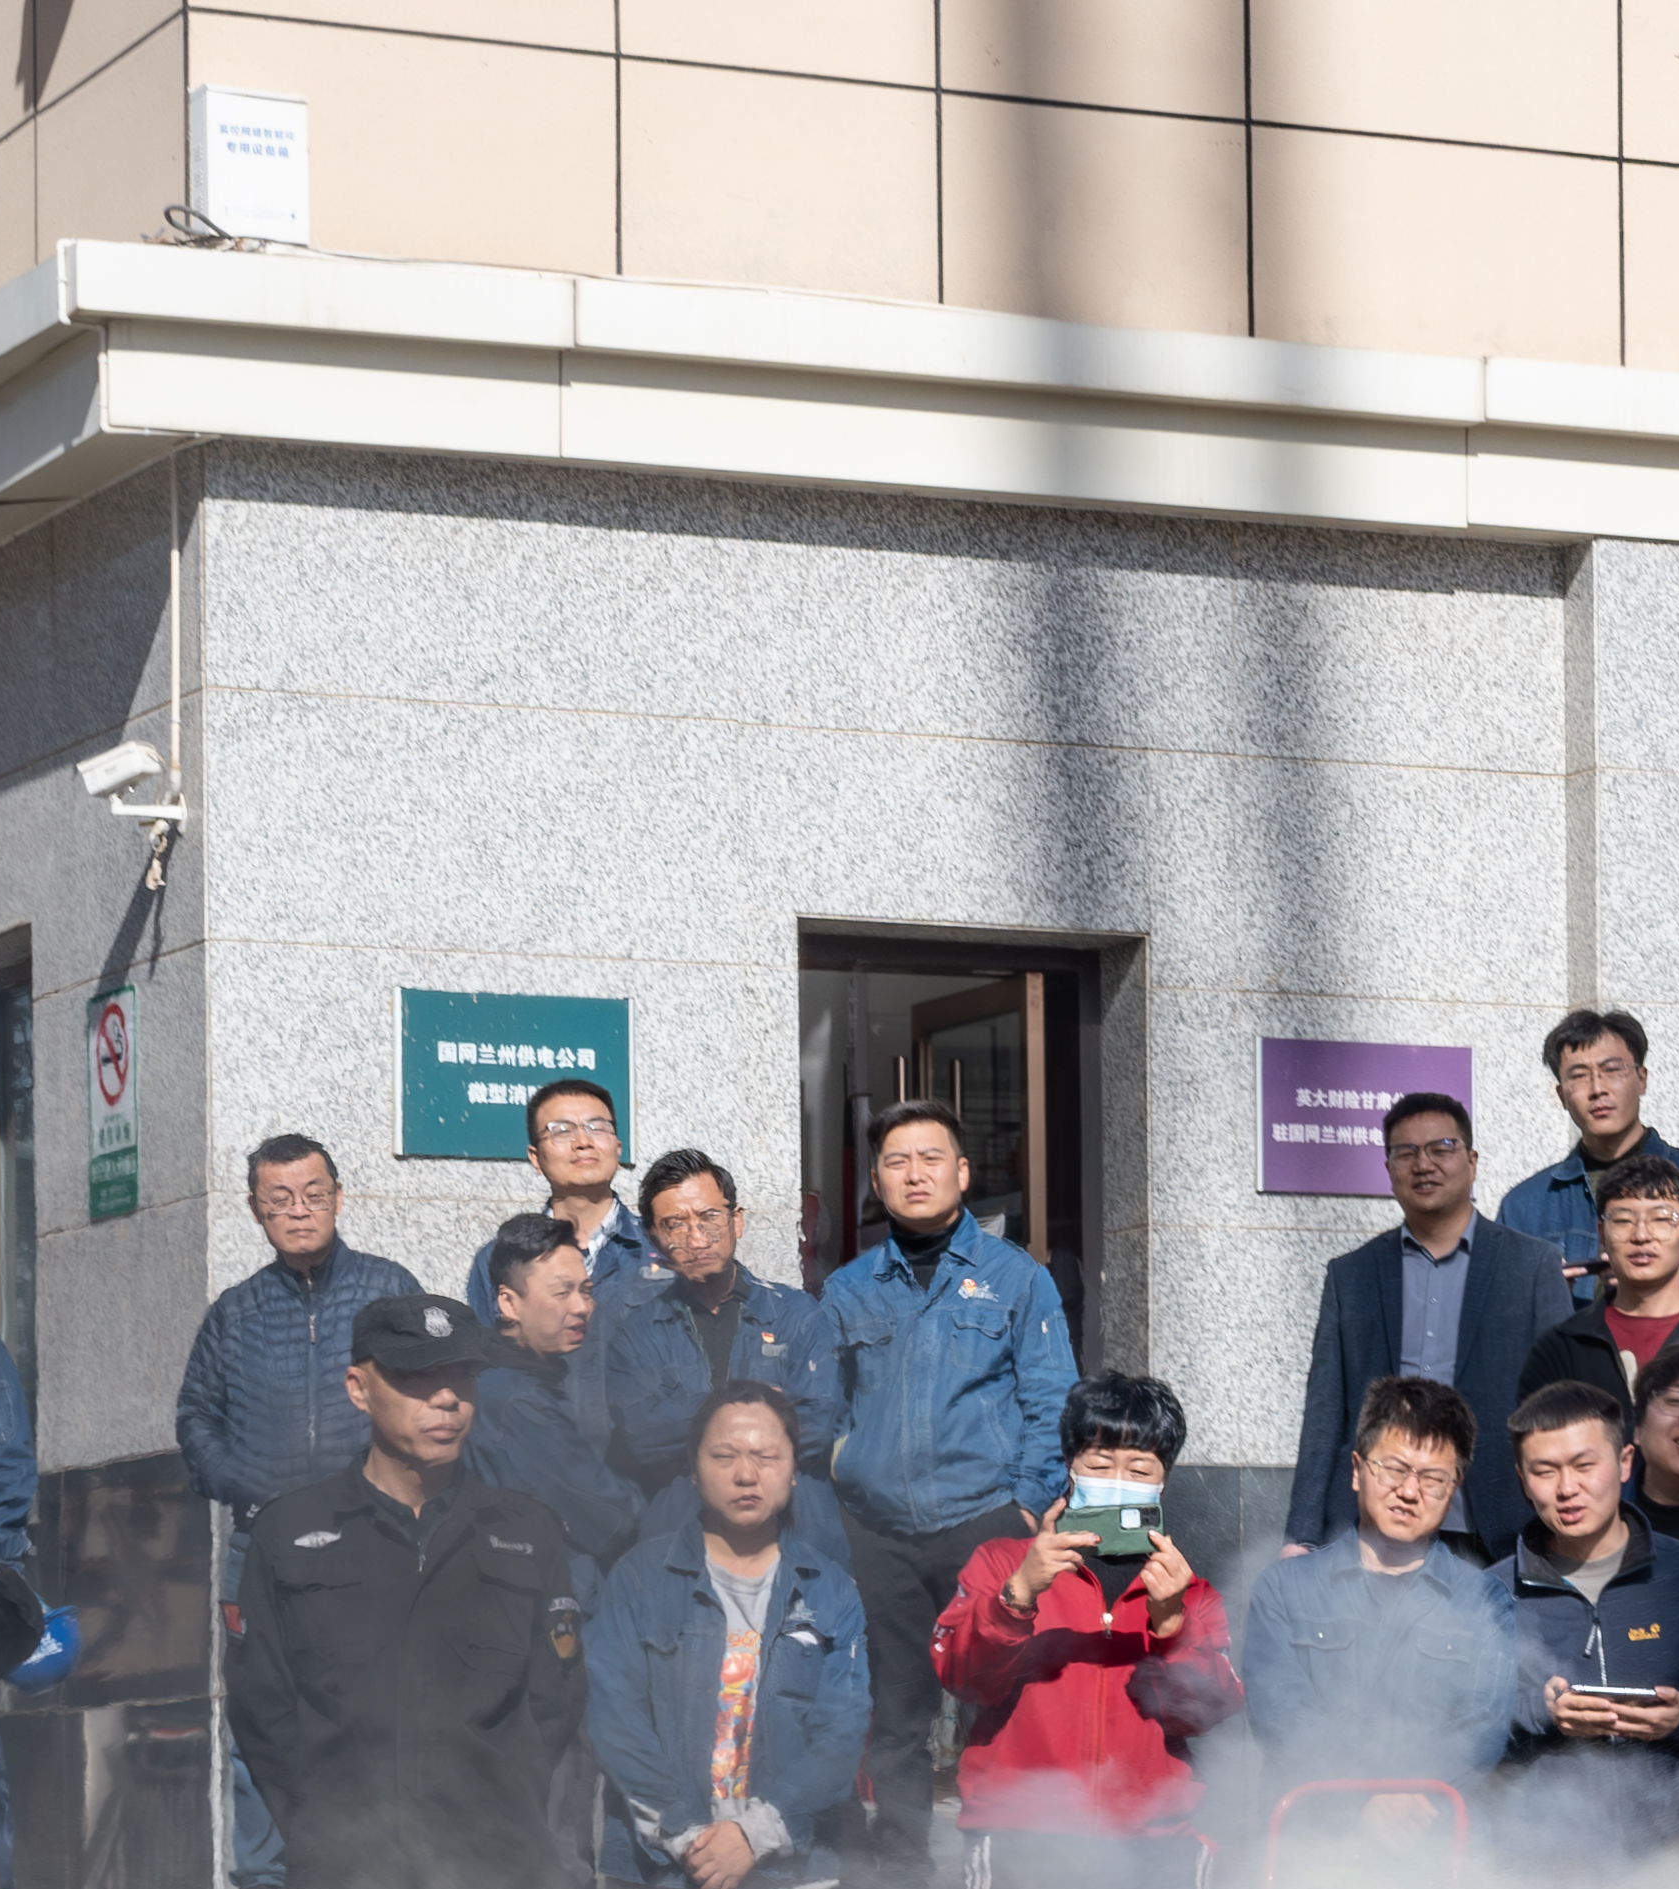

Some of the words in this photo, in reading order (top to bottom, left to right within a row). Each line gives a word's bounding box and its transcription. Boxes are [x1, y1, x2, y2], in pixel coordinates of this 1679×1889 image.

[437, 1040, 596, 1070] 国网兰州供电公司
[1271, 1123, 1385, 1147] 驻国网兰州供电
